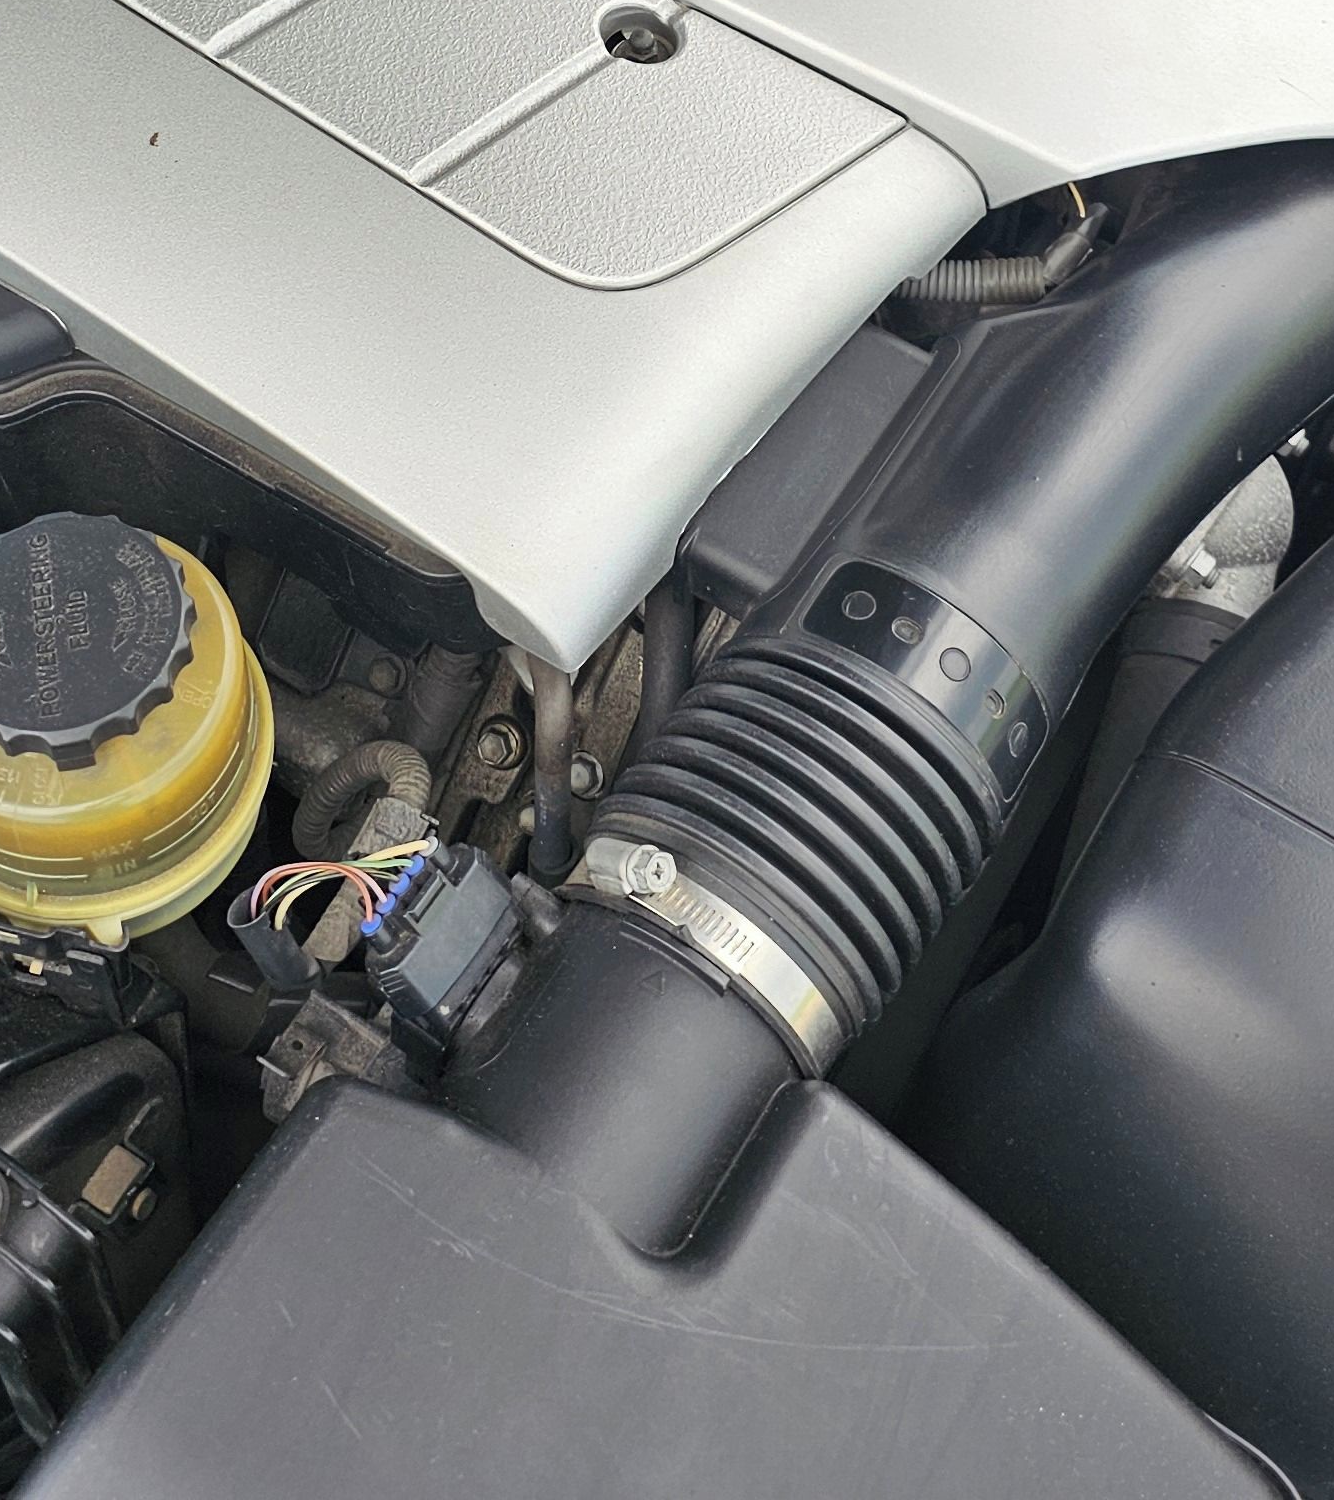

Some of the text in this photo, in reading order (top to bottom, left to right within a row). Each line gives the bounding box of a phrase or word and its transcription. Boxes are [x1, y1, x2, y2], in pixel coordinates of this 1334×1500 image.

[27, 531, 63, 719] POWER STEERING
[66, 589, 92, 651] FLUID
